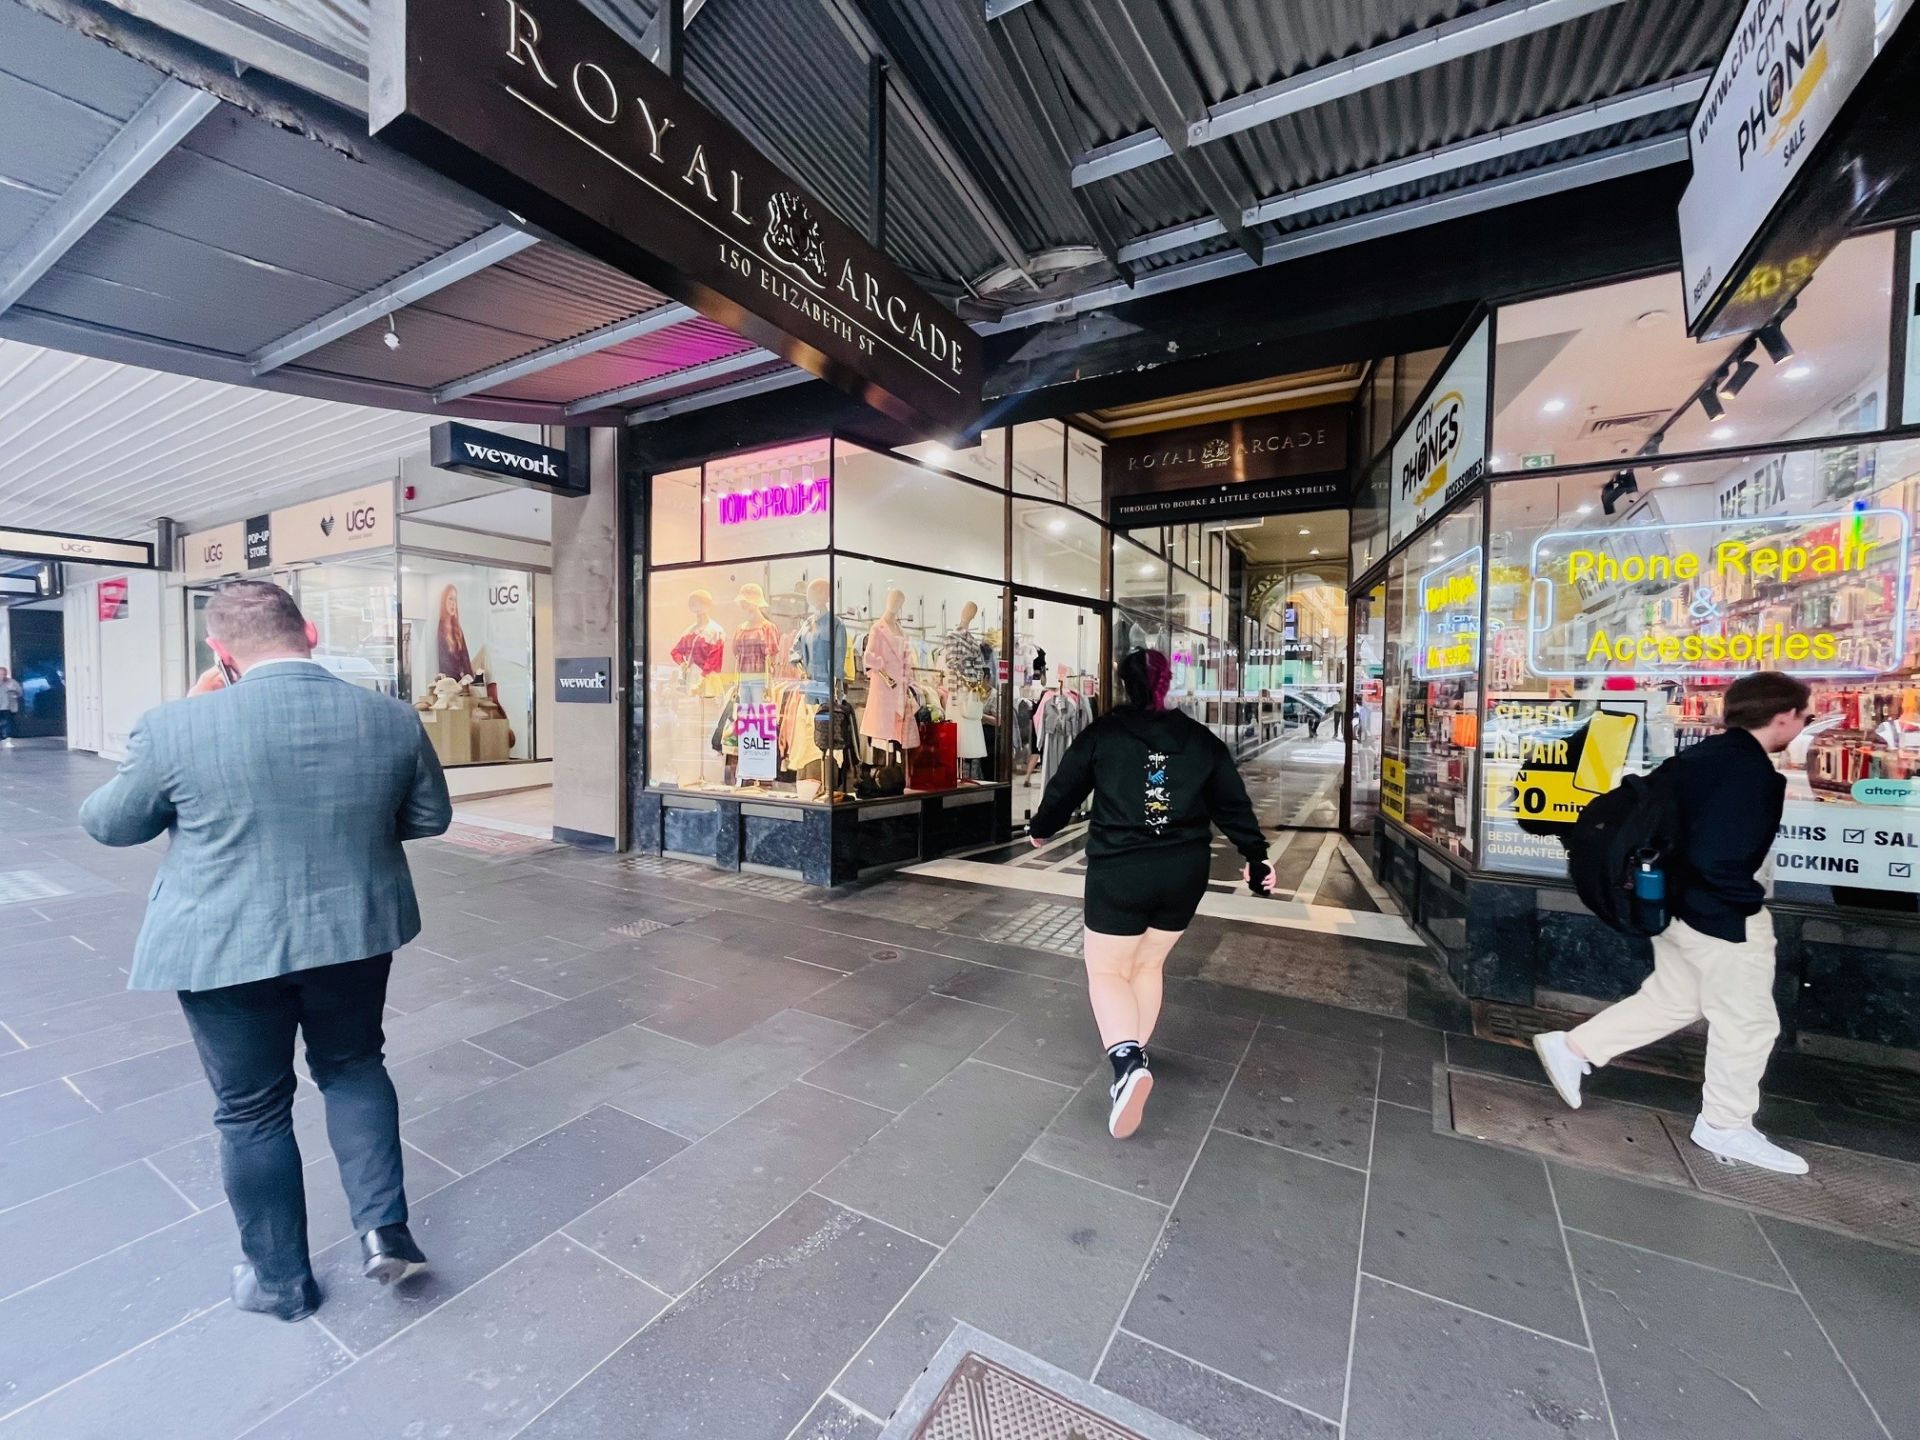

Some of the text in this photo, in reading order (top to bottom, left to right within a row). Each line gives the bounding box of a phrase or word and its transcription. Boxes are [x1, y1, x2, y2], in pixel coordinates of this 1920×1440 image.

[1756, 0, 1786, 76] CITY
[1699, 0, 1771, 144] www.cityp
[1783, 120, 1807, 167] SALE
[506, 0, 963, 375] ROYAL ARCADE
[719, 244, 876, 356] 150 ELIZABETH ST
[1416, 402, 1434, 443] CITY
[1237, 429, 1326, 456] ARCADE
[1402, 403, 1459, 500] PHONES
[464, 442, 559, 477] wework
[1119, 483, 1337, 514] THROUGH TO BOURKE & LITTLE COLLINS STREETS
[346, 506, 376, 532] UGG
[61, 542, 93, 554] UGG
[247, 530, 270, 544] POP-UP
[249, 544, 268, 559] STORE
[204, 543, 223, 563] UGG
[1567, 540, 1880, 585] Phone Repair
[489, 585, 520, 606] UGG
[1689, 587, 1722, 619] &
[1586, 623, 1838, 662] Accessories
[559, 672, 606, 689] wework
[743, 736, 770, 750] SALE
[1496, 785, 1547, 814] 20
[1488, 830, 1522, 843] BEST
[1873, 830, 1919, 848] SAL
